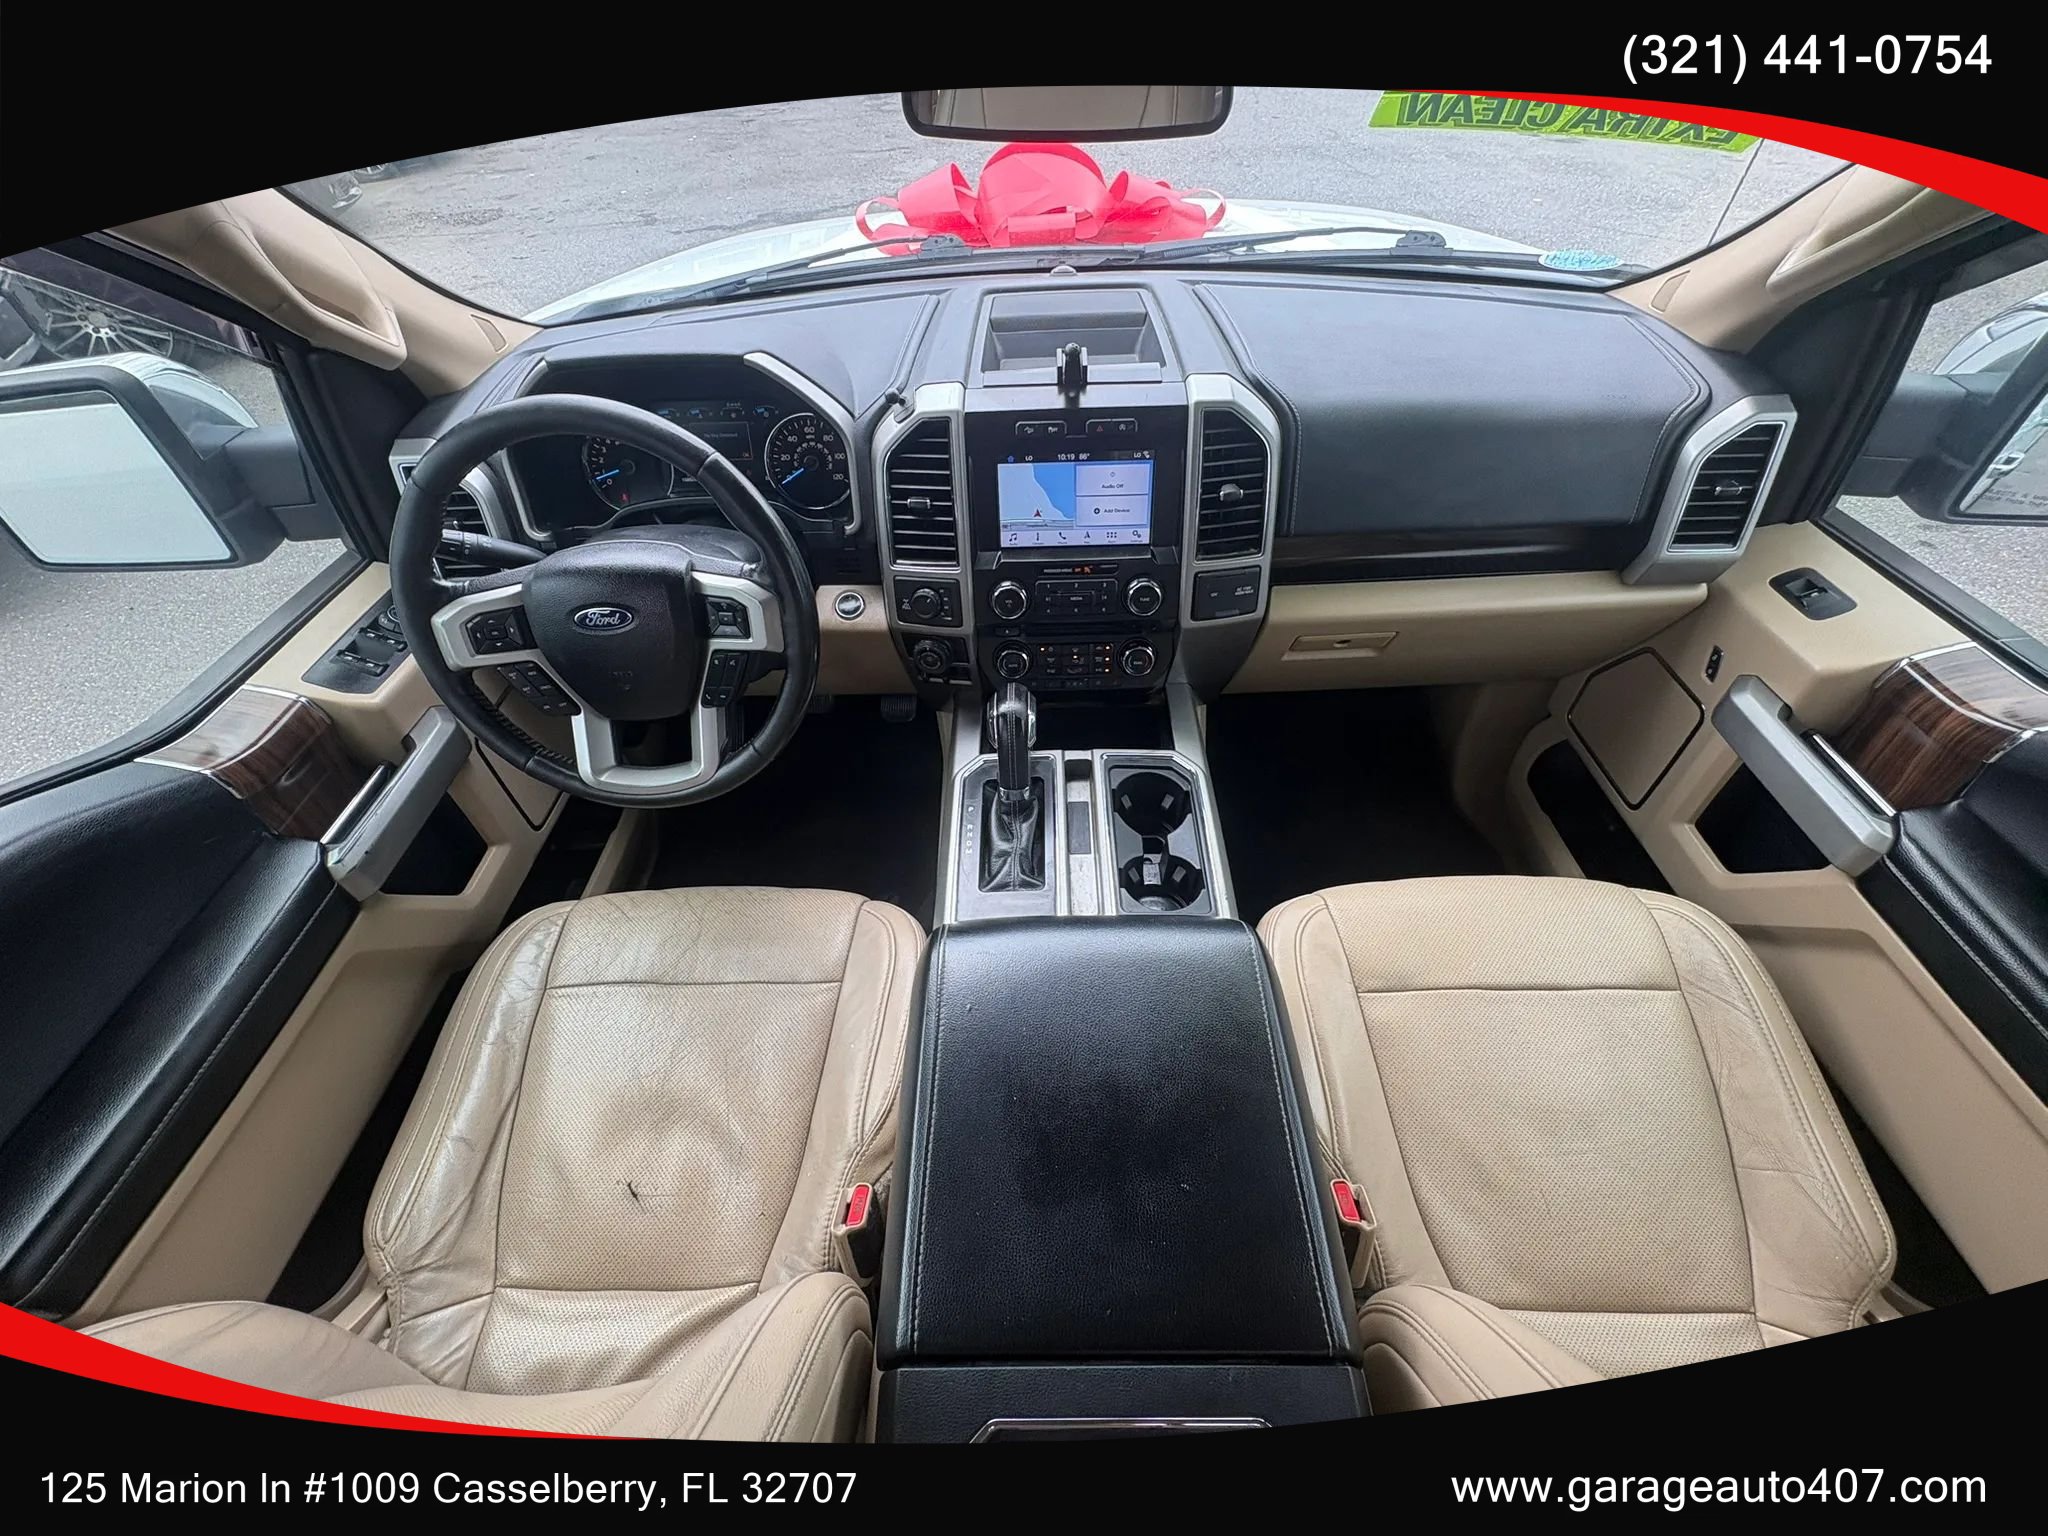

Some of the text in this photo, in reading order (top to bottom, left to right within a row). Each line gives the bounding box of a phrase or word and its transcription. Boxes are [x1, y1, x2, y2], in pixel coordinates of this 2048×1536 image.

[803, 426, 815, 434] 60
[823, 434, 834, 442] 80
[780, 453, 791, 461] 20
[1057, 453, 1076, 461] 10:19
[585, 609, 621, 626] Ford
